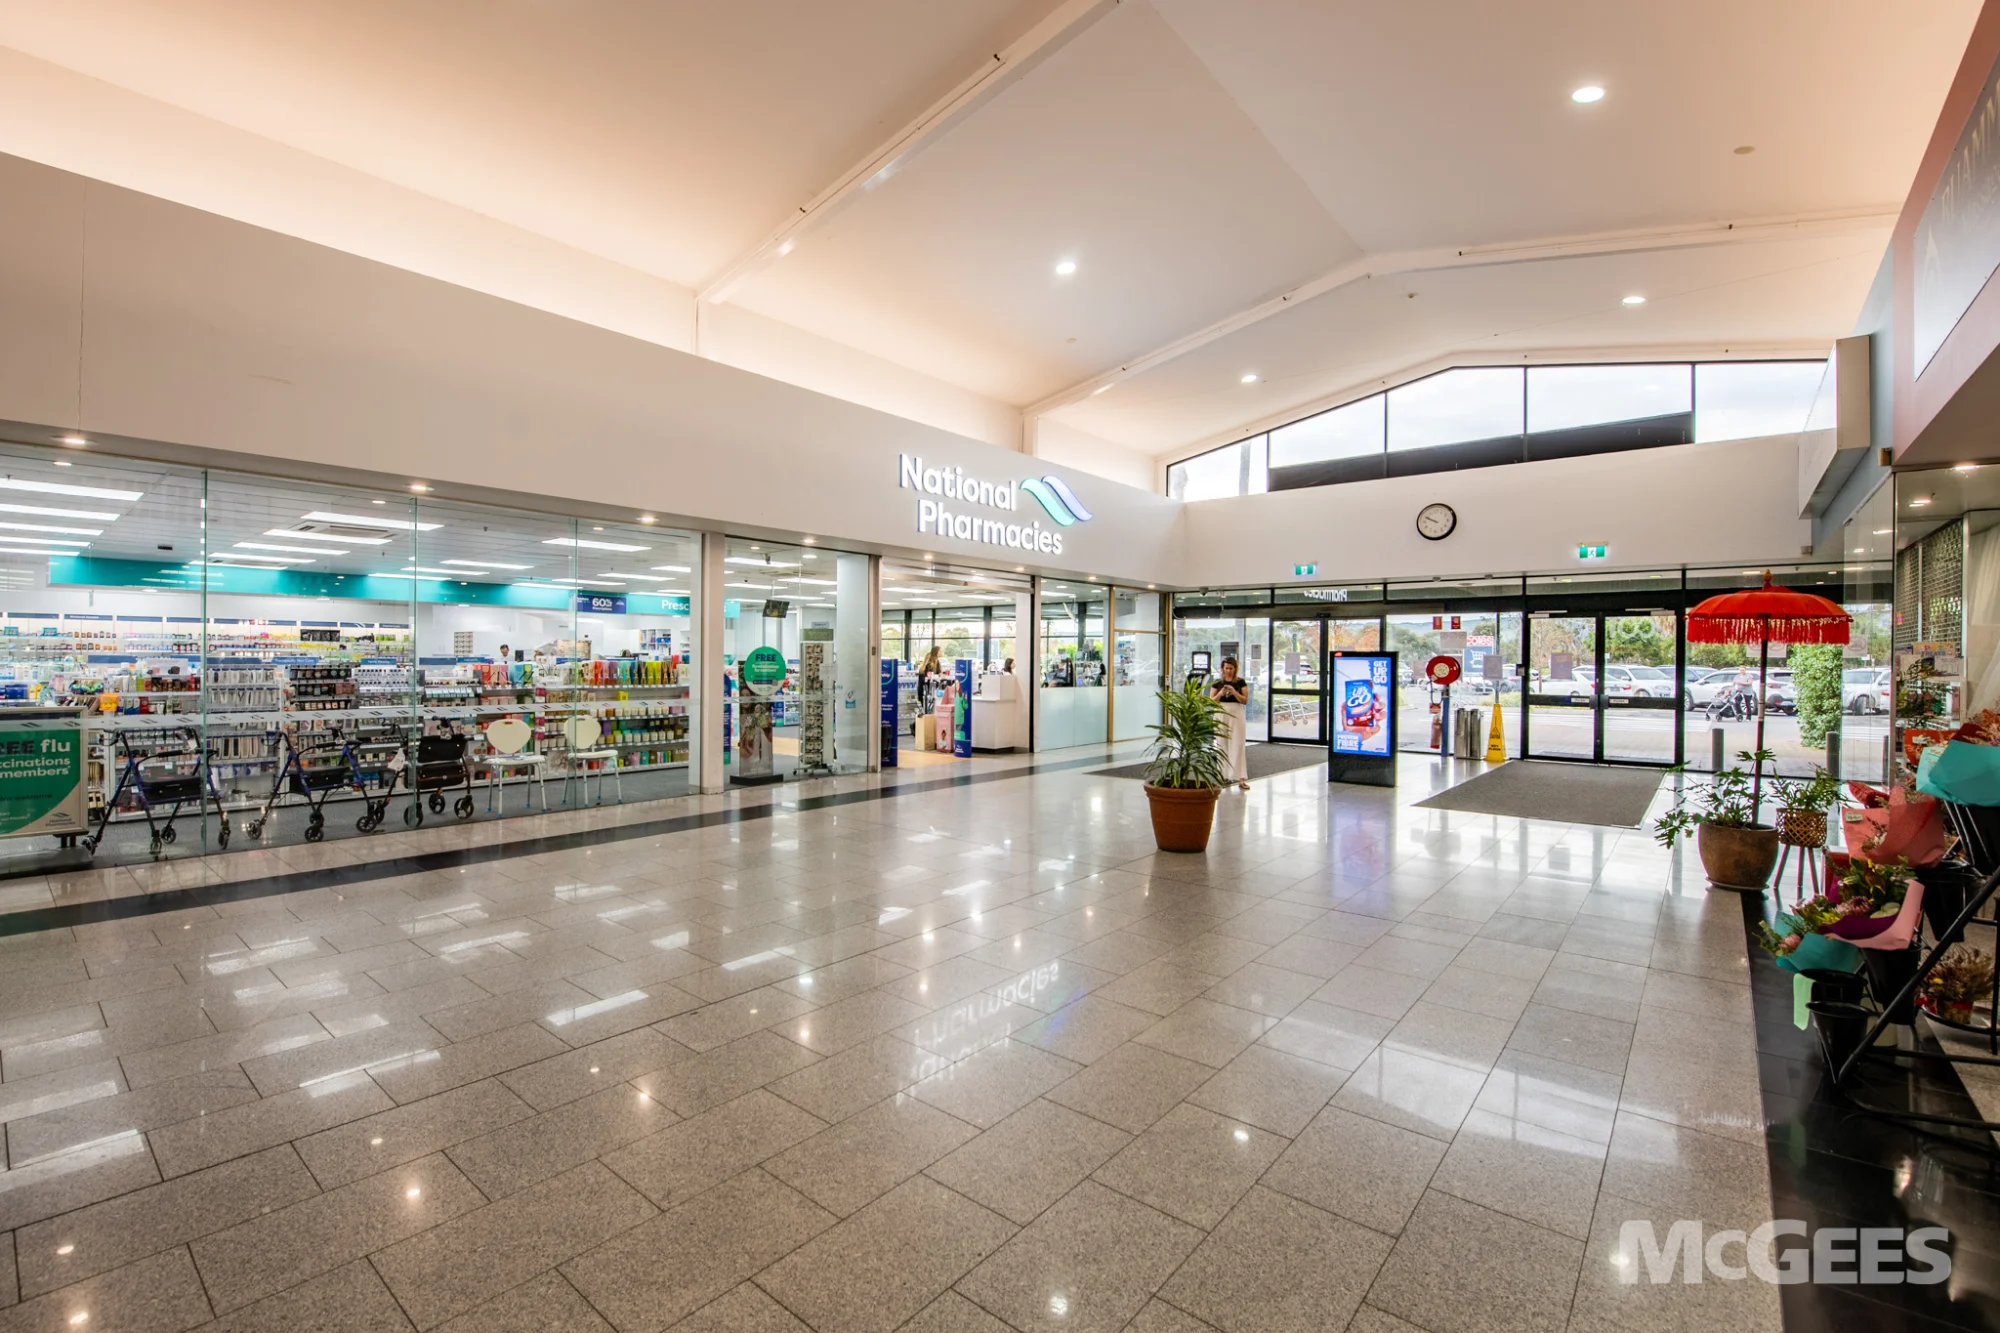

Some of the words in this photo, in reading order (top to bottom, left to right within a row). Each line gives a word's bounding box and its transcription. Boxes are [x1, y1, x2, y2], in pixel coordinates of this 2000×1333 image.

[899, 453, 1016, 512] National
[918, 499, 1063, 555] Pharmacies
[756, 653, 777, 662] FREE
[1373, 676, 1388, 684] GO
[1347, 693, 1371, 707] GO
[40, 738, 71, 753] flu
